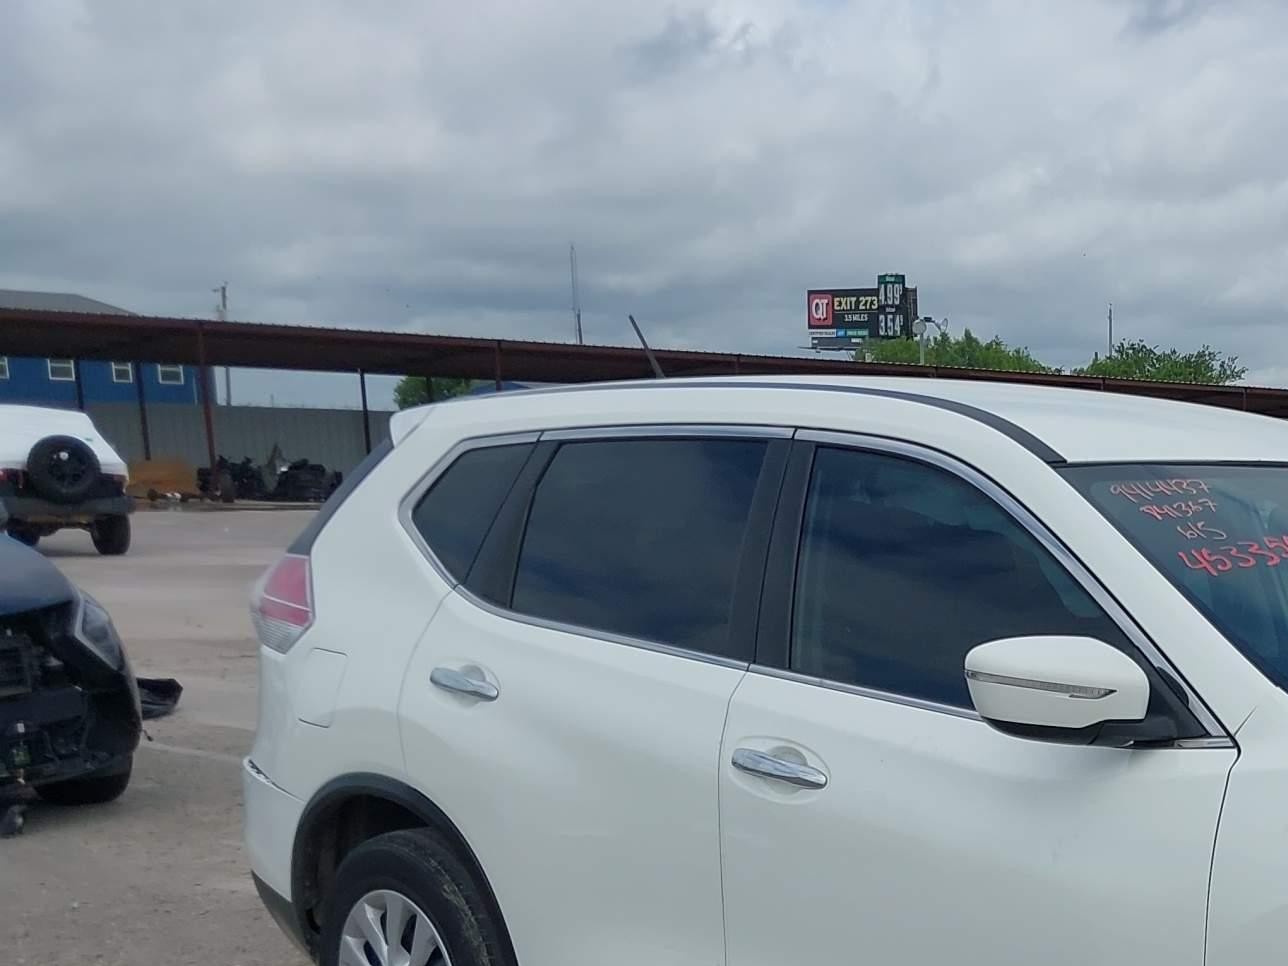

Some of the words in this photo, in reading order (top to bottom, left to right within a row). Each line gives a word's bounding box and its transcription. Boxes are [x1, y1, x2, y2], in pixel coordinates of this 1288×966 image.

[812, 299, 829, 320] QT
[834, 297, 857, 310] EXIT
[859, 296, 878, 310] 273
